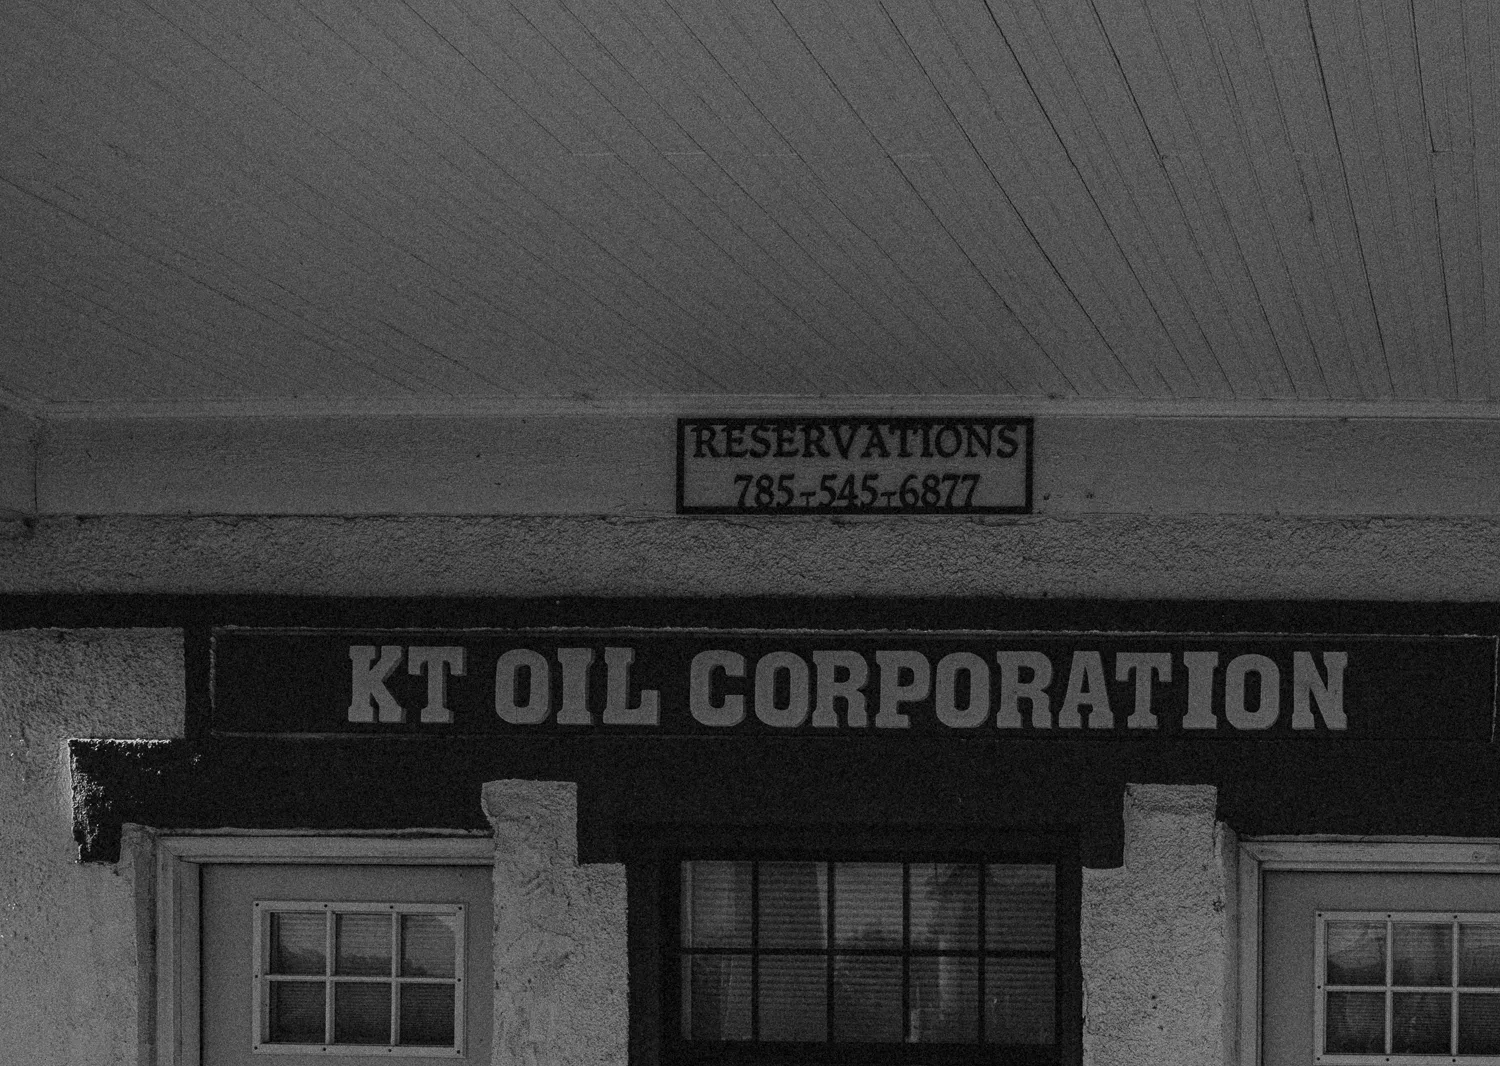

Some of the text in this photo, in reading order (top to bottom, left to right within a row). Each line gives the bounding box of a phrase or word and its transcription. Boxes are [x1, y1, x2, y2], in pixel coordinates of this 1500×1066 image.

[690, 424, 1019, 460] RESERVATIONS
[734, 473, 981, 507] 785-545-6877
[347, 644, 1349, 731] KT OIL CORPORATION
